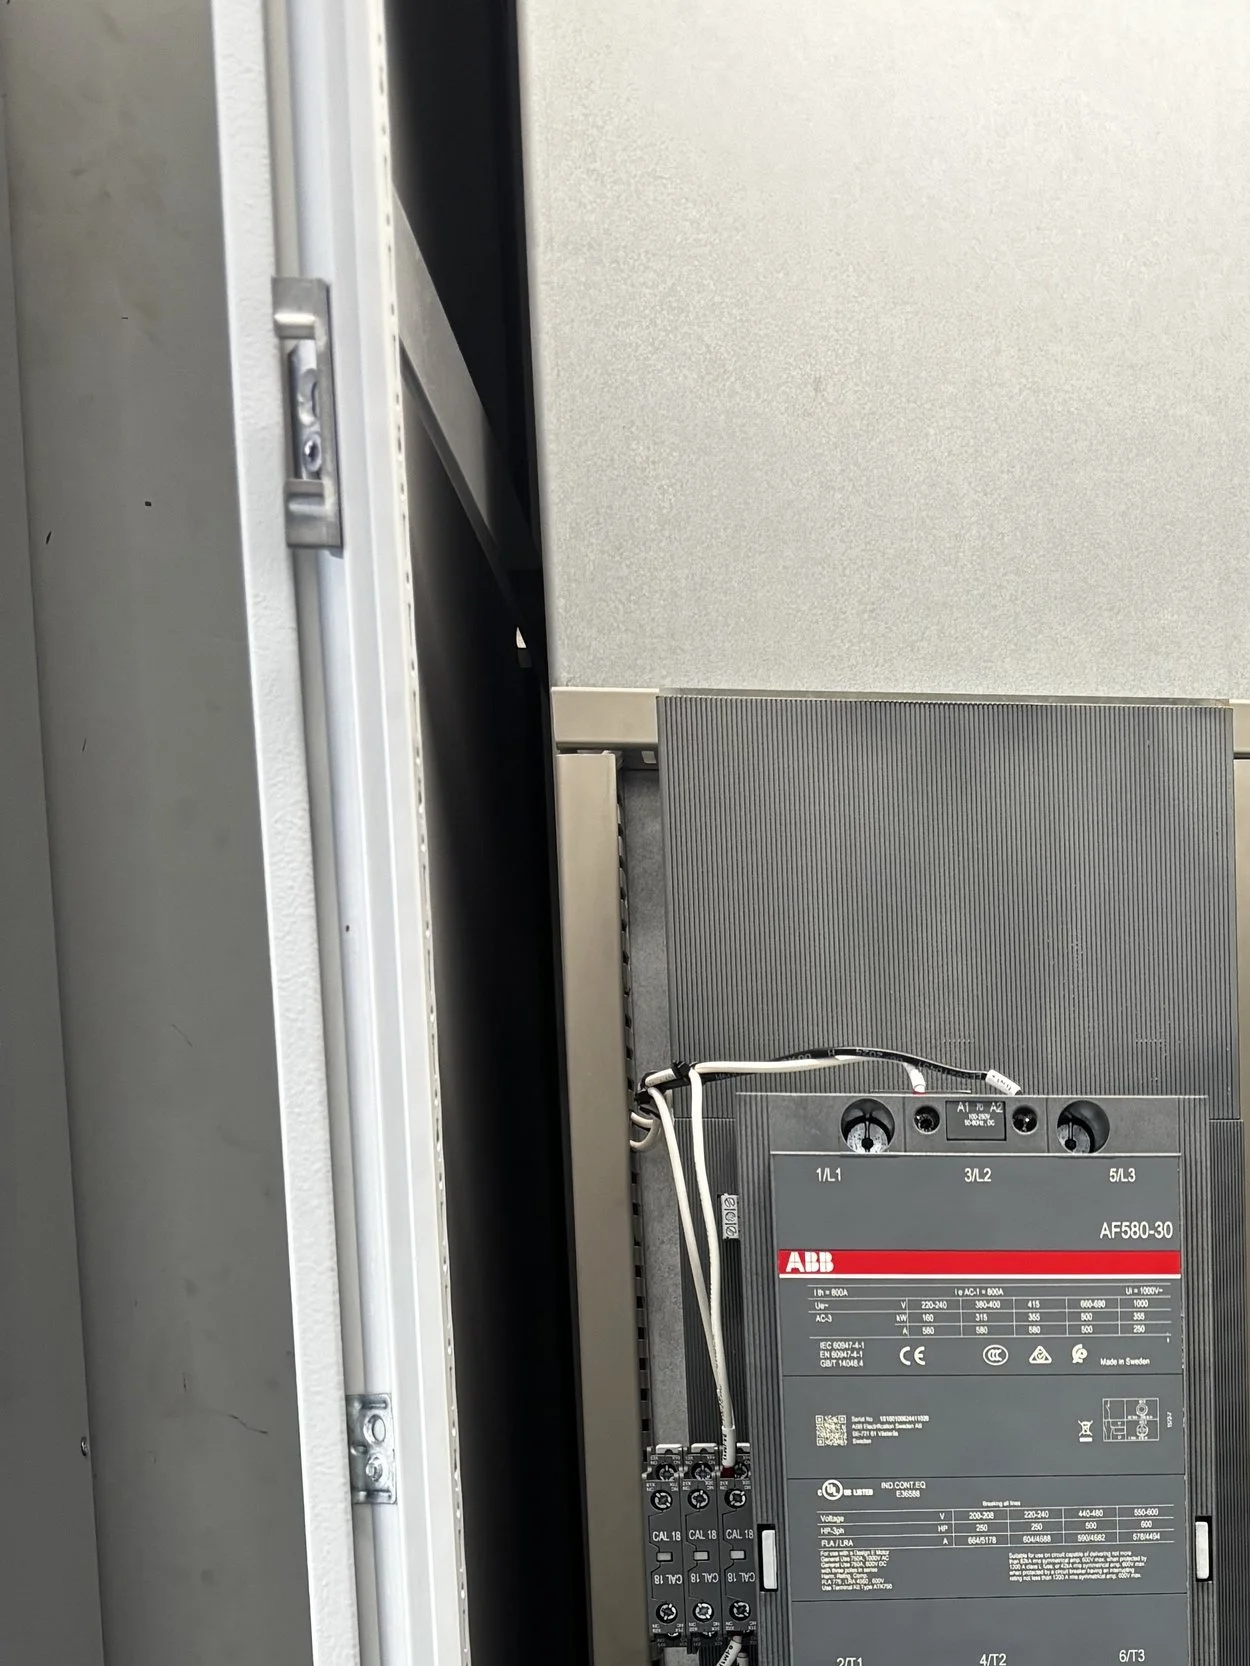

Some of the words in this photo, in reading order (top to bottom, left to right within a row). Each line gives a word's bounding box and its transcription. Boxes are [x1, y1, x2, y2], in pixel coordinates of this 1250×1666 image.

[957, 1102, 969, 1113] A1
[990, 1102, 1003, 1113] A2
[816, 1168, 843, 1183] 1/L1
[964, 1168, 992, 1183] 3/L2
[1109, 1168, 1137, 1183] 5/L3
[1099, 1222, 1174, 1240] AF580-30
[786, 1252, 835, 1273] ABB
[921, 1301, 948, 1310] 220-240
[975, 1300, 1001, 1309] 380-400
[1027, 1300, 1040, 1308] 415
[1133, 1299, 1149, 1308] 1000
[816, 1314, 833, 1323] AC-3
[1028, 1312, 1040, 1321] 355
[1133, 1324, 1146, 1333] 250
[819, 1341, 832, 1350] IEC
[832, 1341, 865, 1350] 60947-4-1
[819, 1351, 830, 1359] EN
[831, 1351, 863, 1360] 60947-4-1
[1099, 1358, 1116, 1366] Made
[1118, 1358, 1124, 1366] in
[1125, 1357, 1151, 1366] Sweden
[820, 1514, 845, 1524] Voltage
[939, 1512, 945, 1521] V
[968, 1511, 995, 1520] 200-208
[1024, 1510, 1050, 1519] 220-240
[1078, 1509, 1104, 1518] 440-480
[1133, 1508, 1159, 1517] 550-600
[689, 1530, 706, 1539] CAL
[708, 1529, 717, 1539] 18
[726, 1529, 743, 1539] CAL
[745, 1529, 754, 1538] 18
[820, 1526, 845, 1536] HP-3ph
[976, 1524, 988, 1532] 250
[1031, 1523, 1043, 1531] 250
[653, 1532, 670, 1541] CAL
[672, 1531, 681, 1541] 18
[821, 1540, 834, 1549] FLA
[839, 1539, 854, 1548] LRA
[654, 1574, 664, 1584] 18
[665, 1574, 683, 1584] CAL
[691, 1572, 700, 1582] 18
[701, 1572, 719, 1582] CAL
[728, 1572, 737, 1581] 18
[738, 1571, 756, 1582] CAL
[1119, 1649, 1146, 1664] 6/T3
